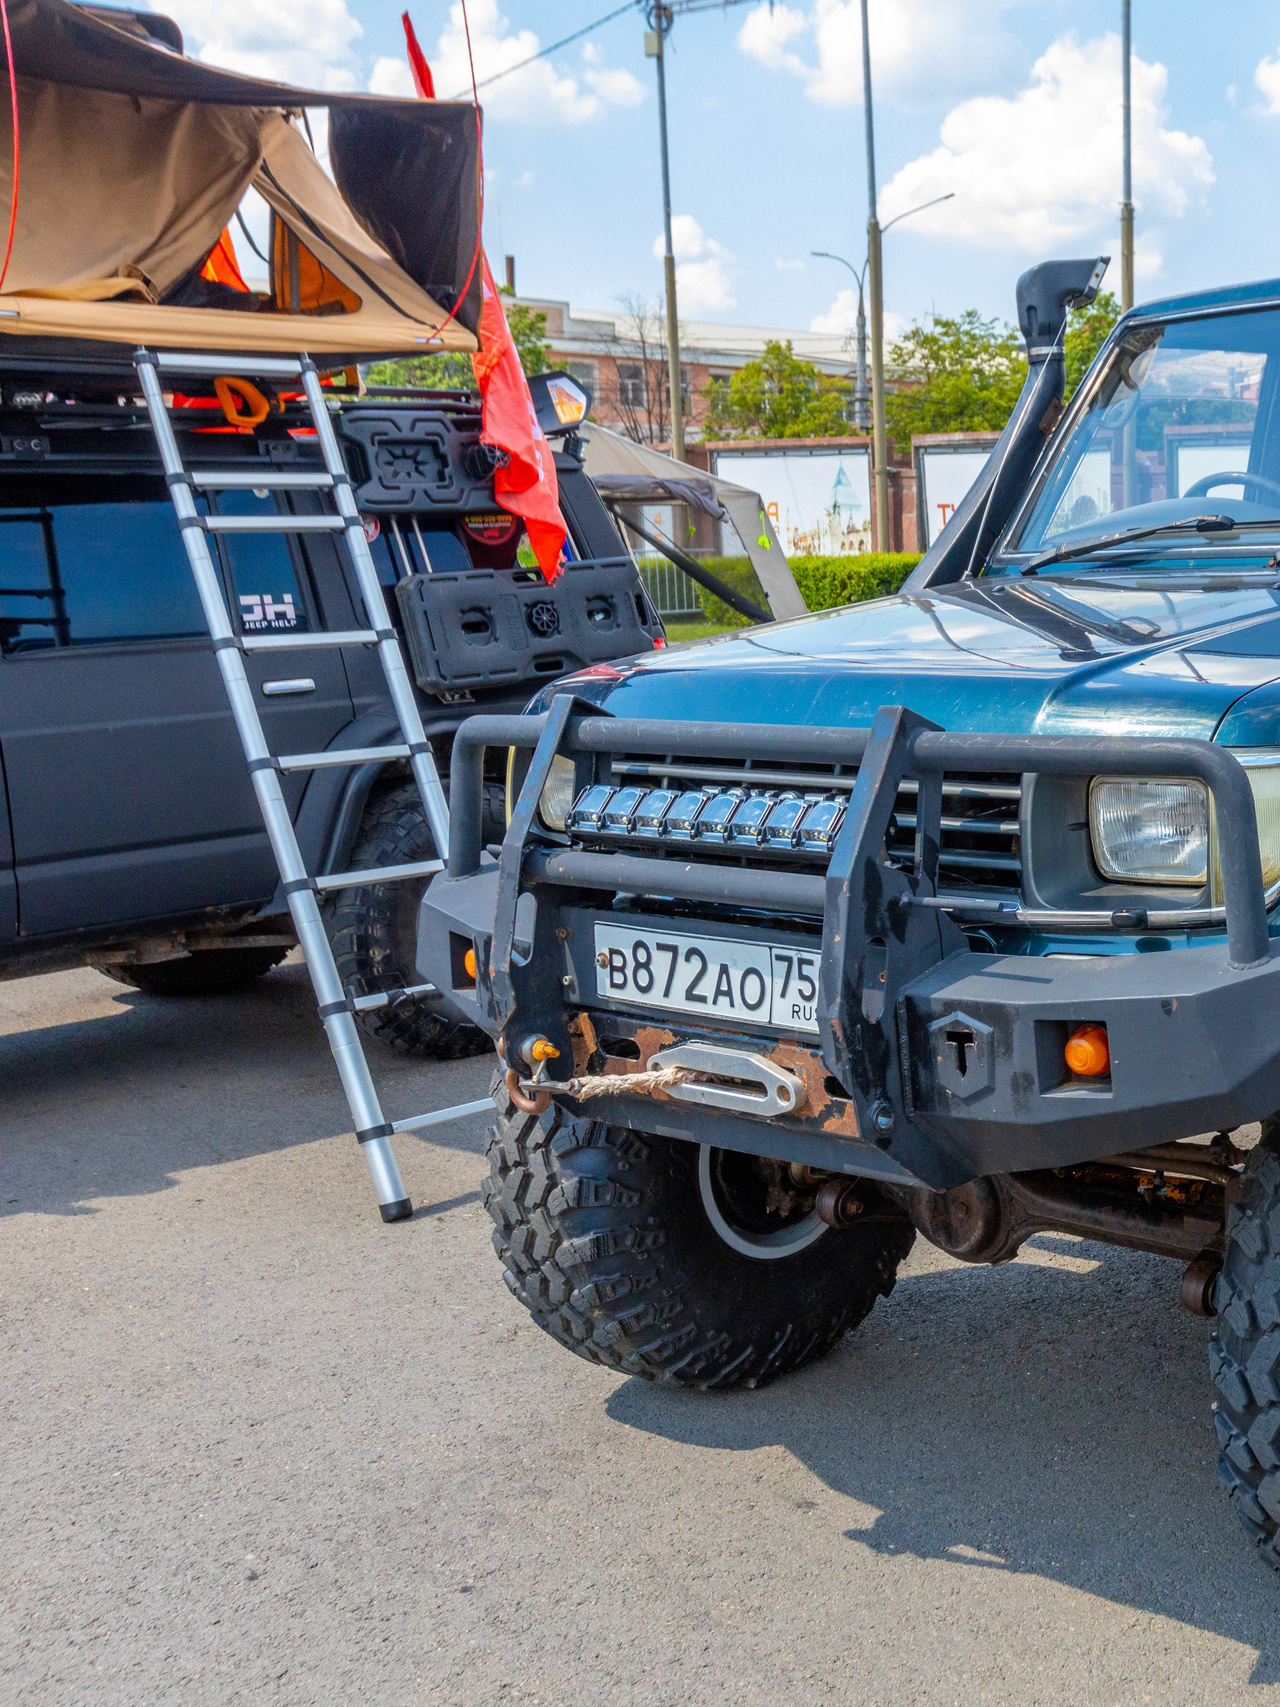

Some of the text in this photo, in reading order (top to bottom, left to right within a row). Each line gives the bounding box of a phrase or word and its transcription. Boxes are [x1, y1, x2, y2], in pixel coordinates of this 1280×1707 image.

[245, 619, 297, 630] JEEP HELP
[791, 1003, 818, 1022] RU
